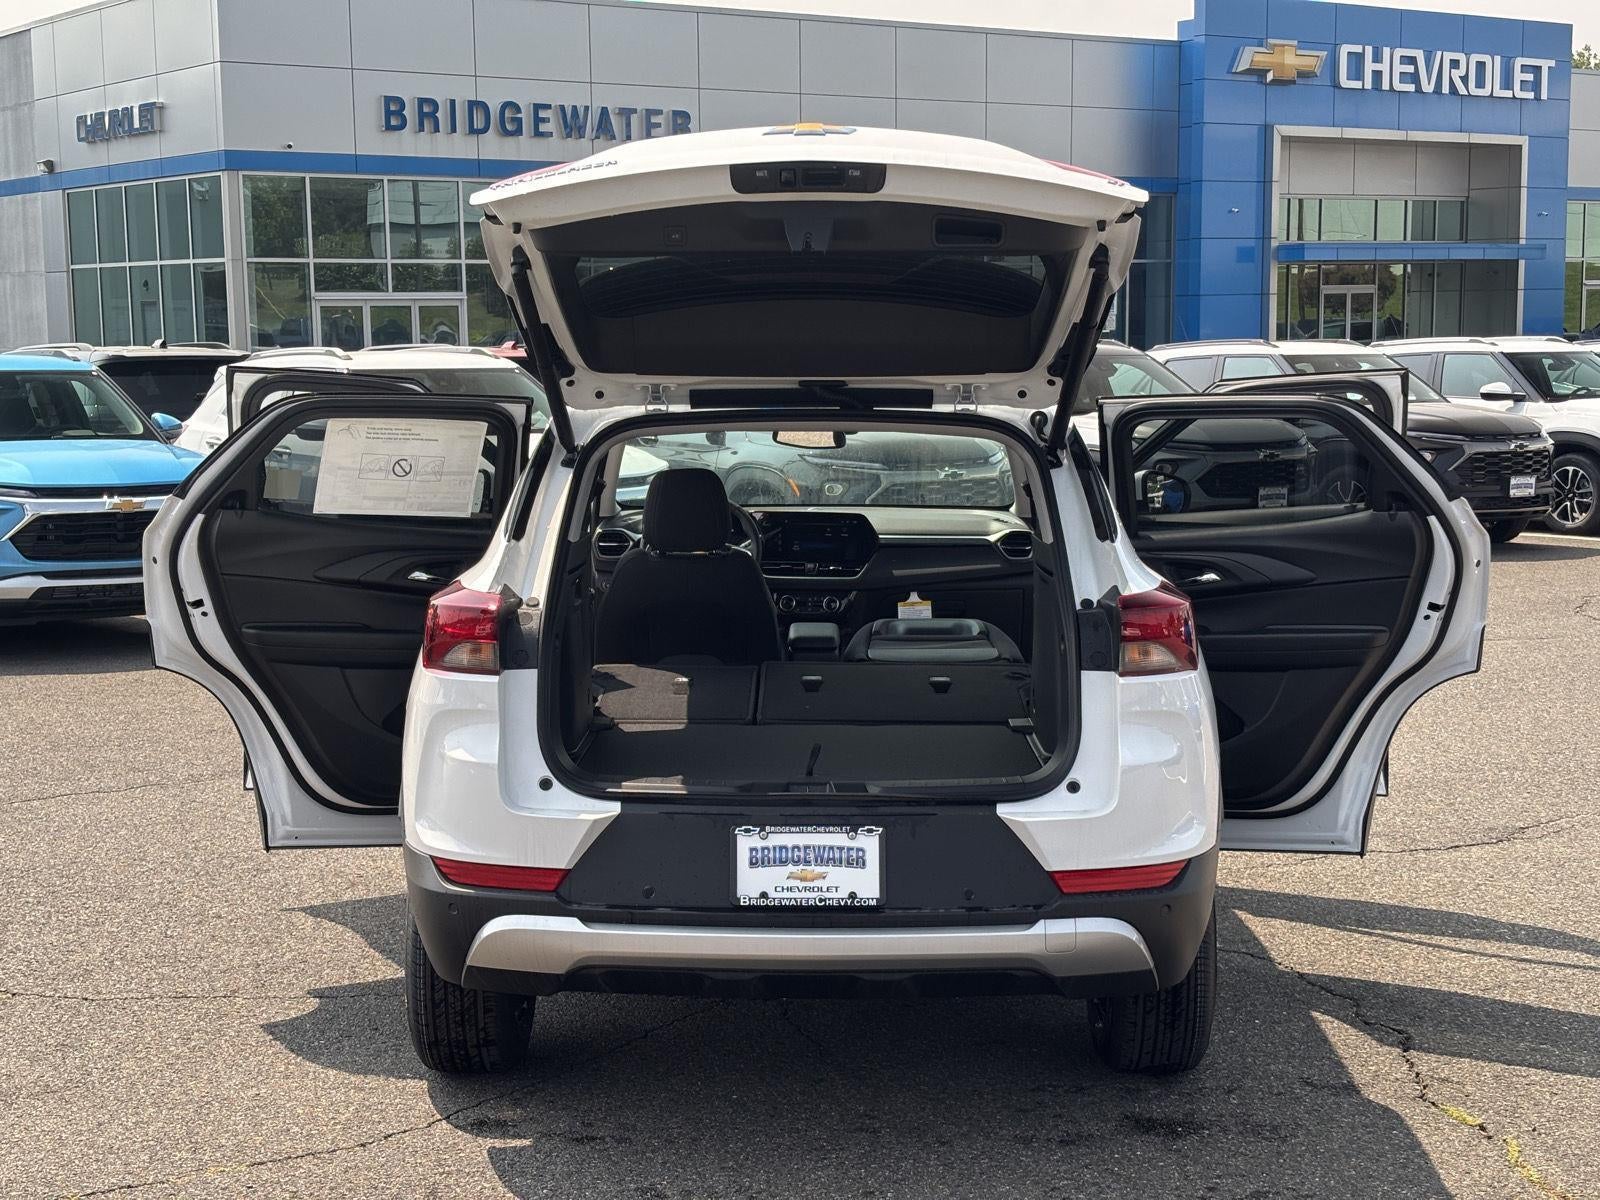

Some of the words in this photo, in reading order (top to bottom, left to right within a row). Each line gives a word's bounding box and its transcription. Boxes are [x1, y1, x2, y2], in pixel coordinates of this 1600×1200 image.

[1338, 43, 1556, 100] CHEVROLET
[76, 101, 163, 143] CHEVROLET
[382, 95, 692, 141] BRIDGEWATER
[748, 845, 867, 869] BRIDGEWATER
[774, 885, 840, 893] CHEVROLET
